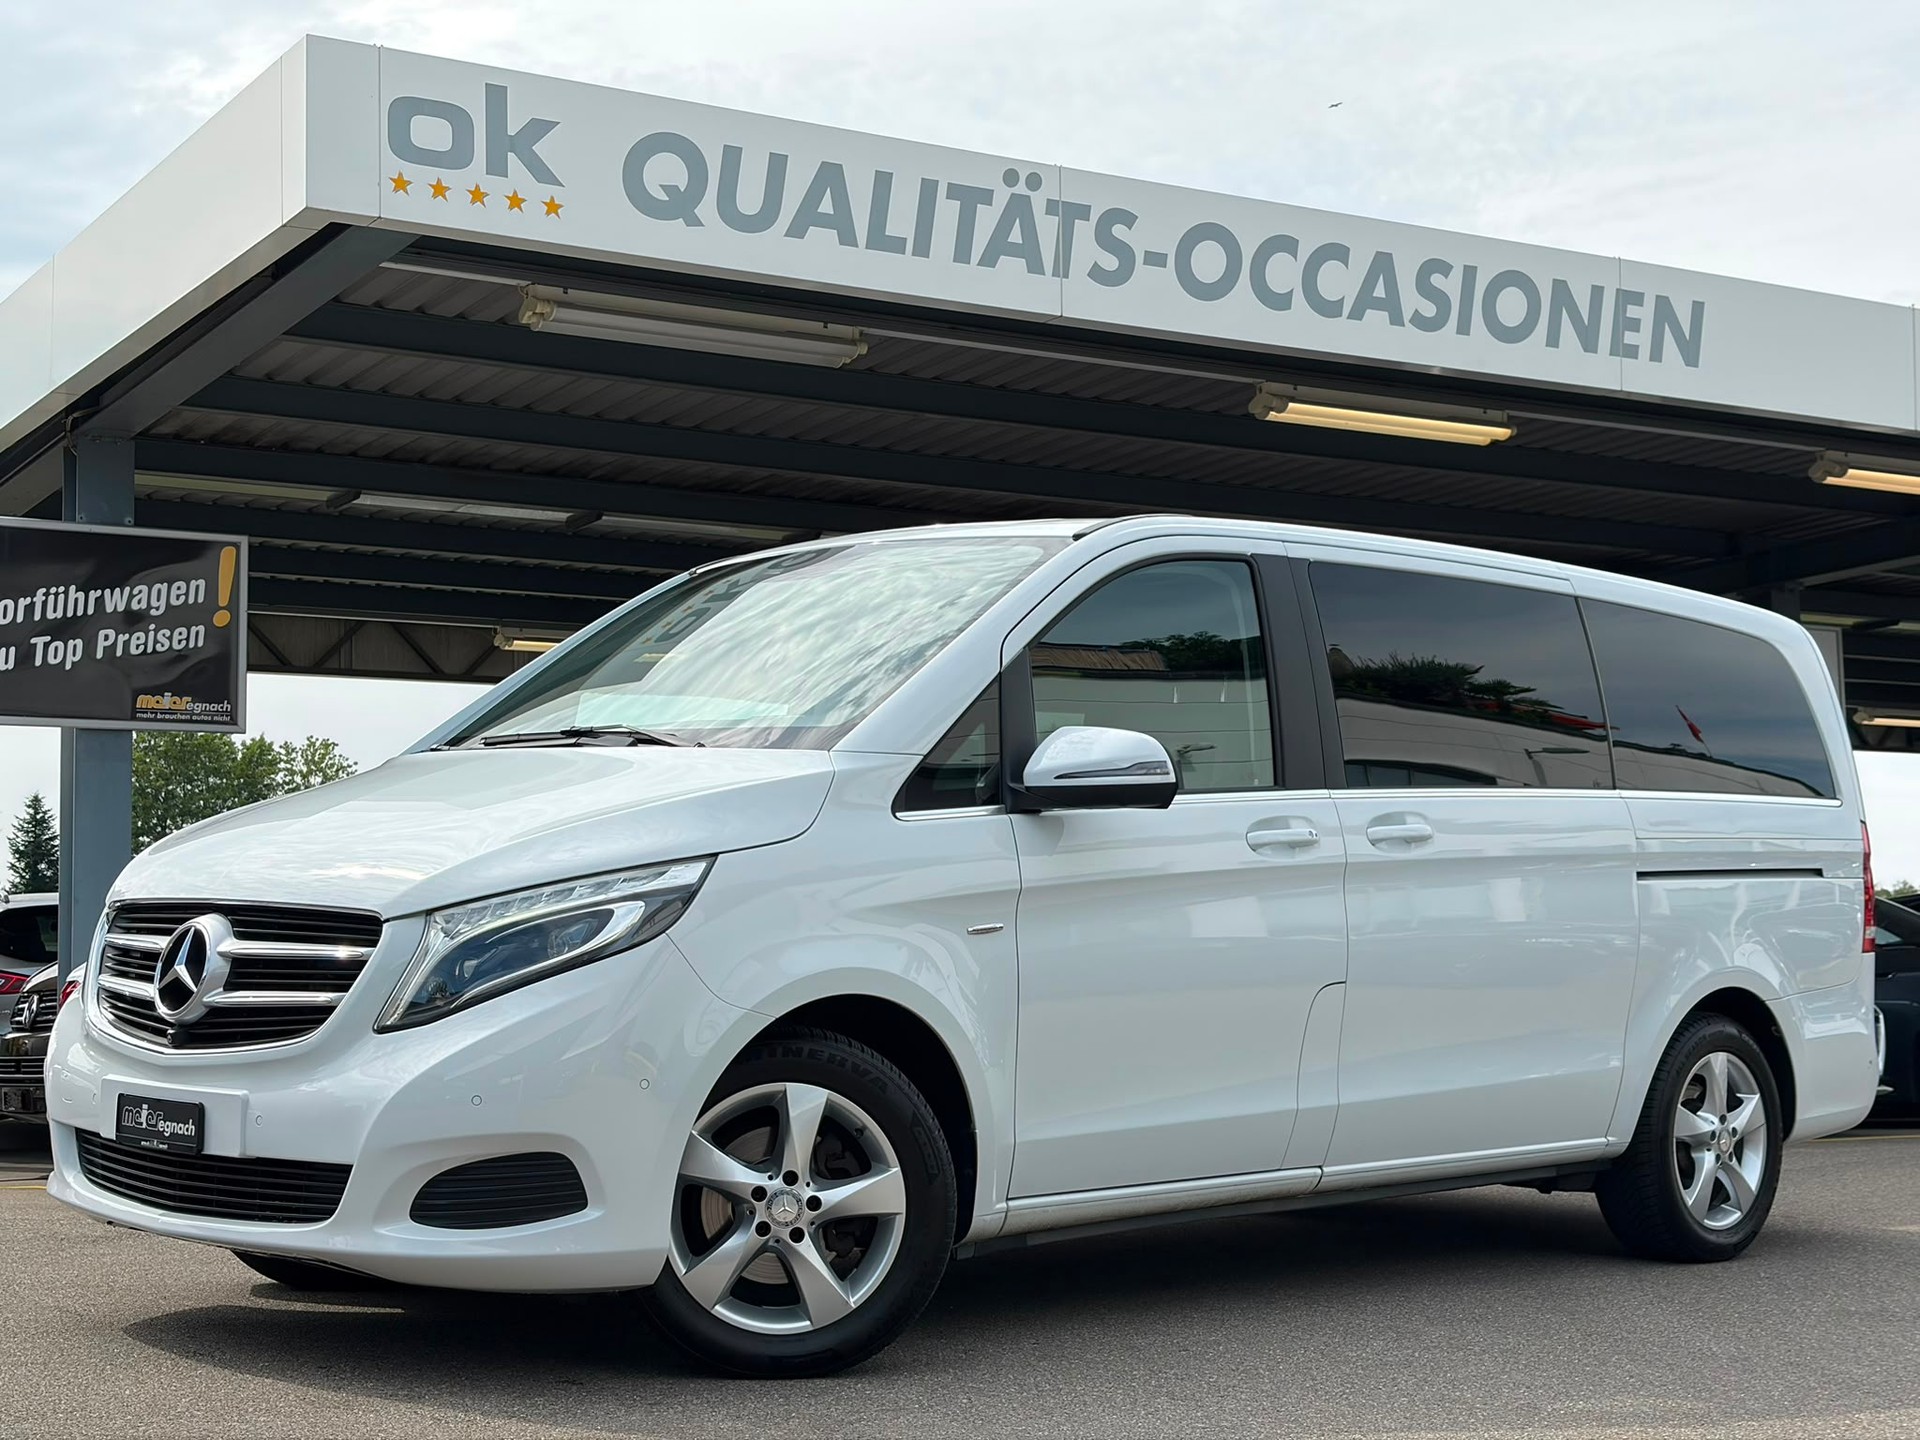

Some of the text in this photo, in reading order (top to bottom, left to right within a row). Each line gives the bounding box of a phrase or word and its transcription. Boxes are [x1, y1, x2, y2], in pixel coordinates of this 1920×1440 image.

[622, 131, 1706, 369] QUALITÄTS-OCCASIONEN
[30, 635, 84, 671] Top
[95, 624, 205, 660] Preisen
[157, 712, 190, 720] brauchen
[213, 714, 231, 722] nicht
